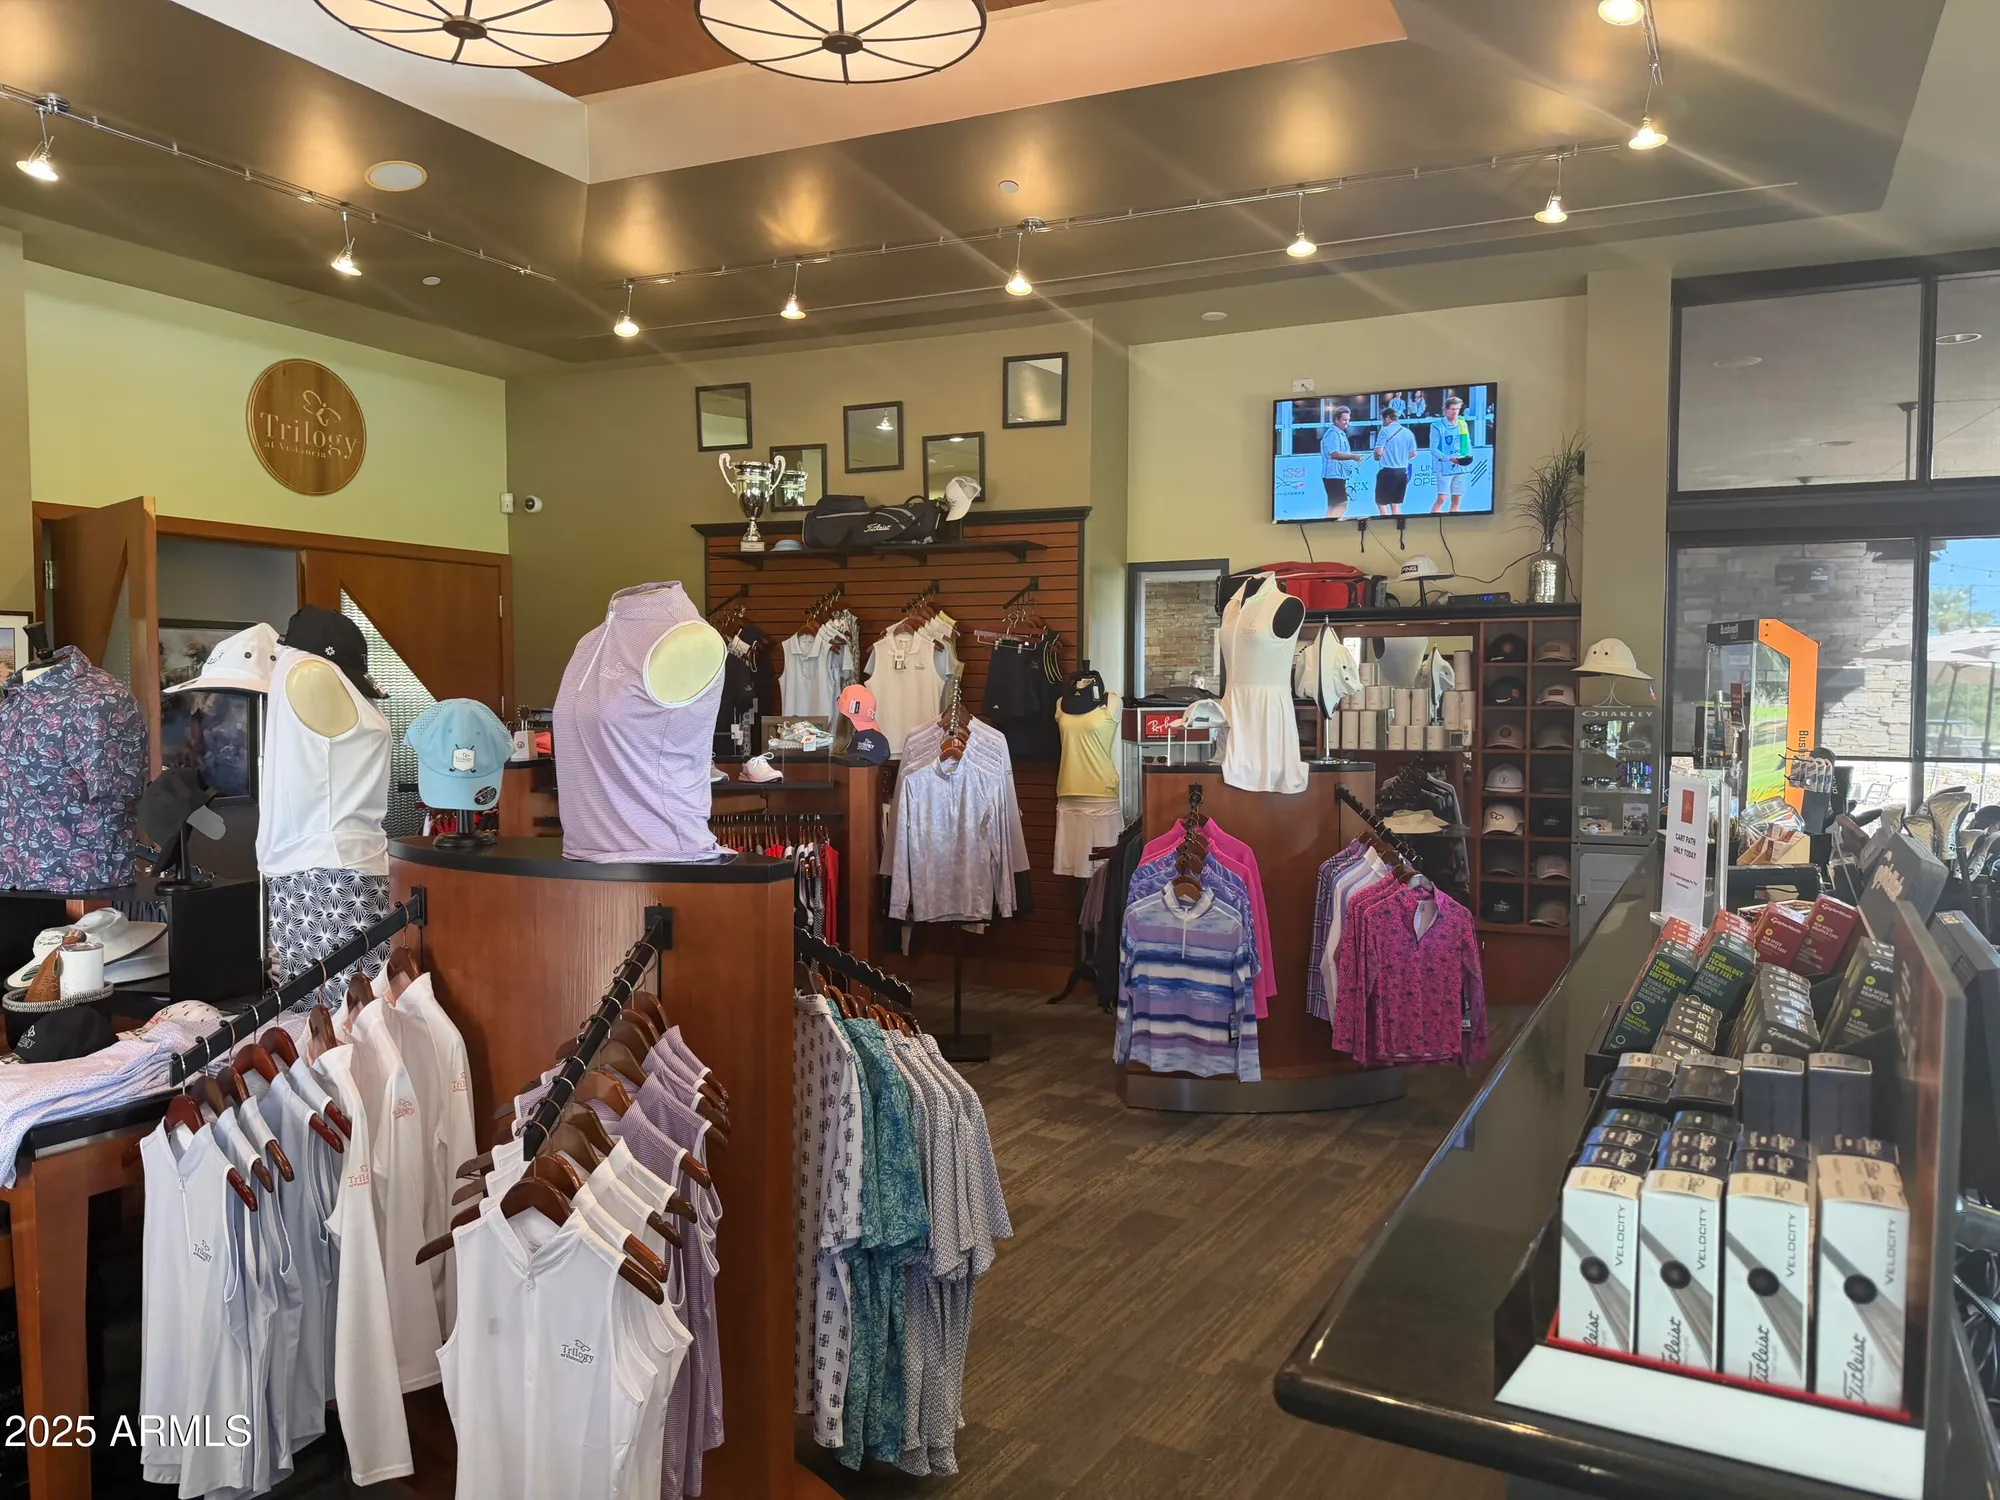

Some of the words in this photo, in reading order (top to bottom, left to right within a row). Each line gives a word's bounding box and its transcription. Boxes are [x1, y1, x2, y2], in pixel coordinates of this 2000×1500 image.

[260, 412, 356, 459] Trilogy
[1413, 477, 1437, 487] OPE
[1420, 464, 1434, 472] LIN
[1673, 845, 1683, 855] ONLY
[1684, 848, 1697, 860] TODAY
[1675, 833, 1686, 843] CART
[1686, 836, 1696, 846] PATH
[1648, 969, 1663, 980] SOFT
[1704, 962, 1719, 973] SOFT
[1615, 1204, 1626, 1267] VELOCITY
[1697, 1207, 1708, 1271] VELOCITY
[1786, 1213, 1797, 1278] VELOCITY
[1885, 1218, 1897, 1285] VELOCITY
[1583, 1310, 1599, 1347] leist
[561, 1344, 595, 1364] Trilogy
[1843, 1333, 1867, 1405] Titleist
